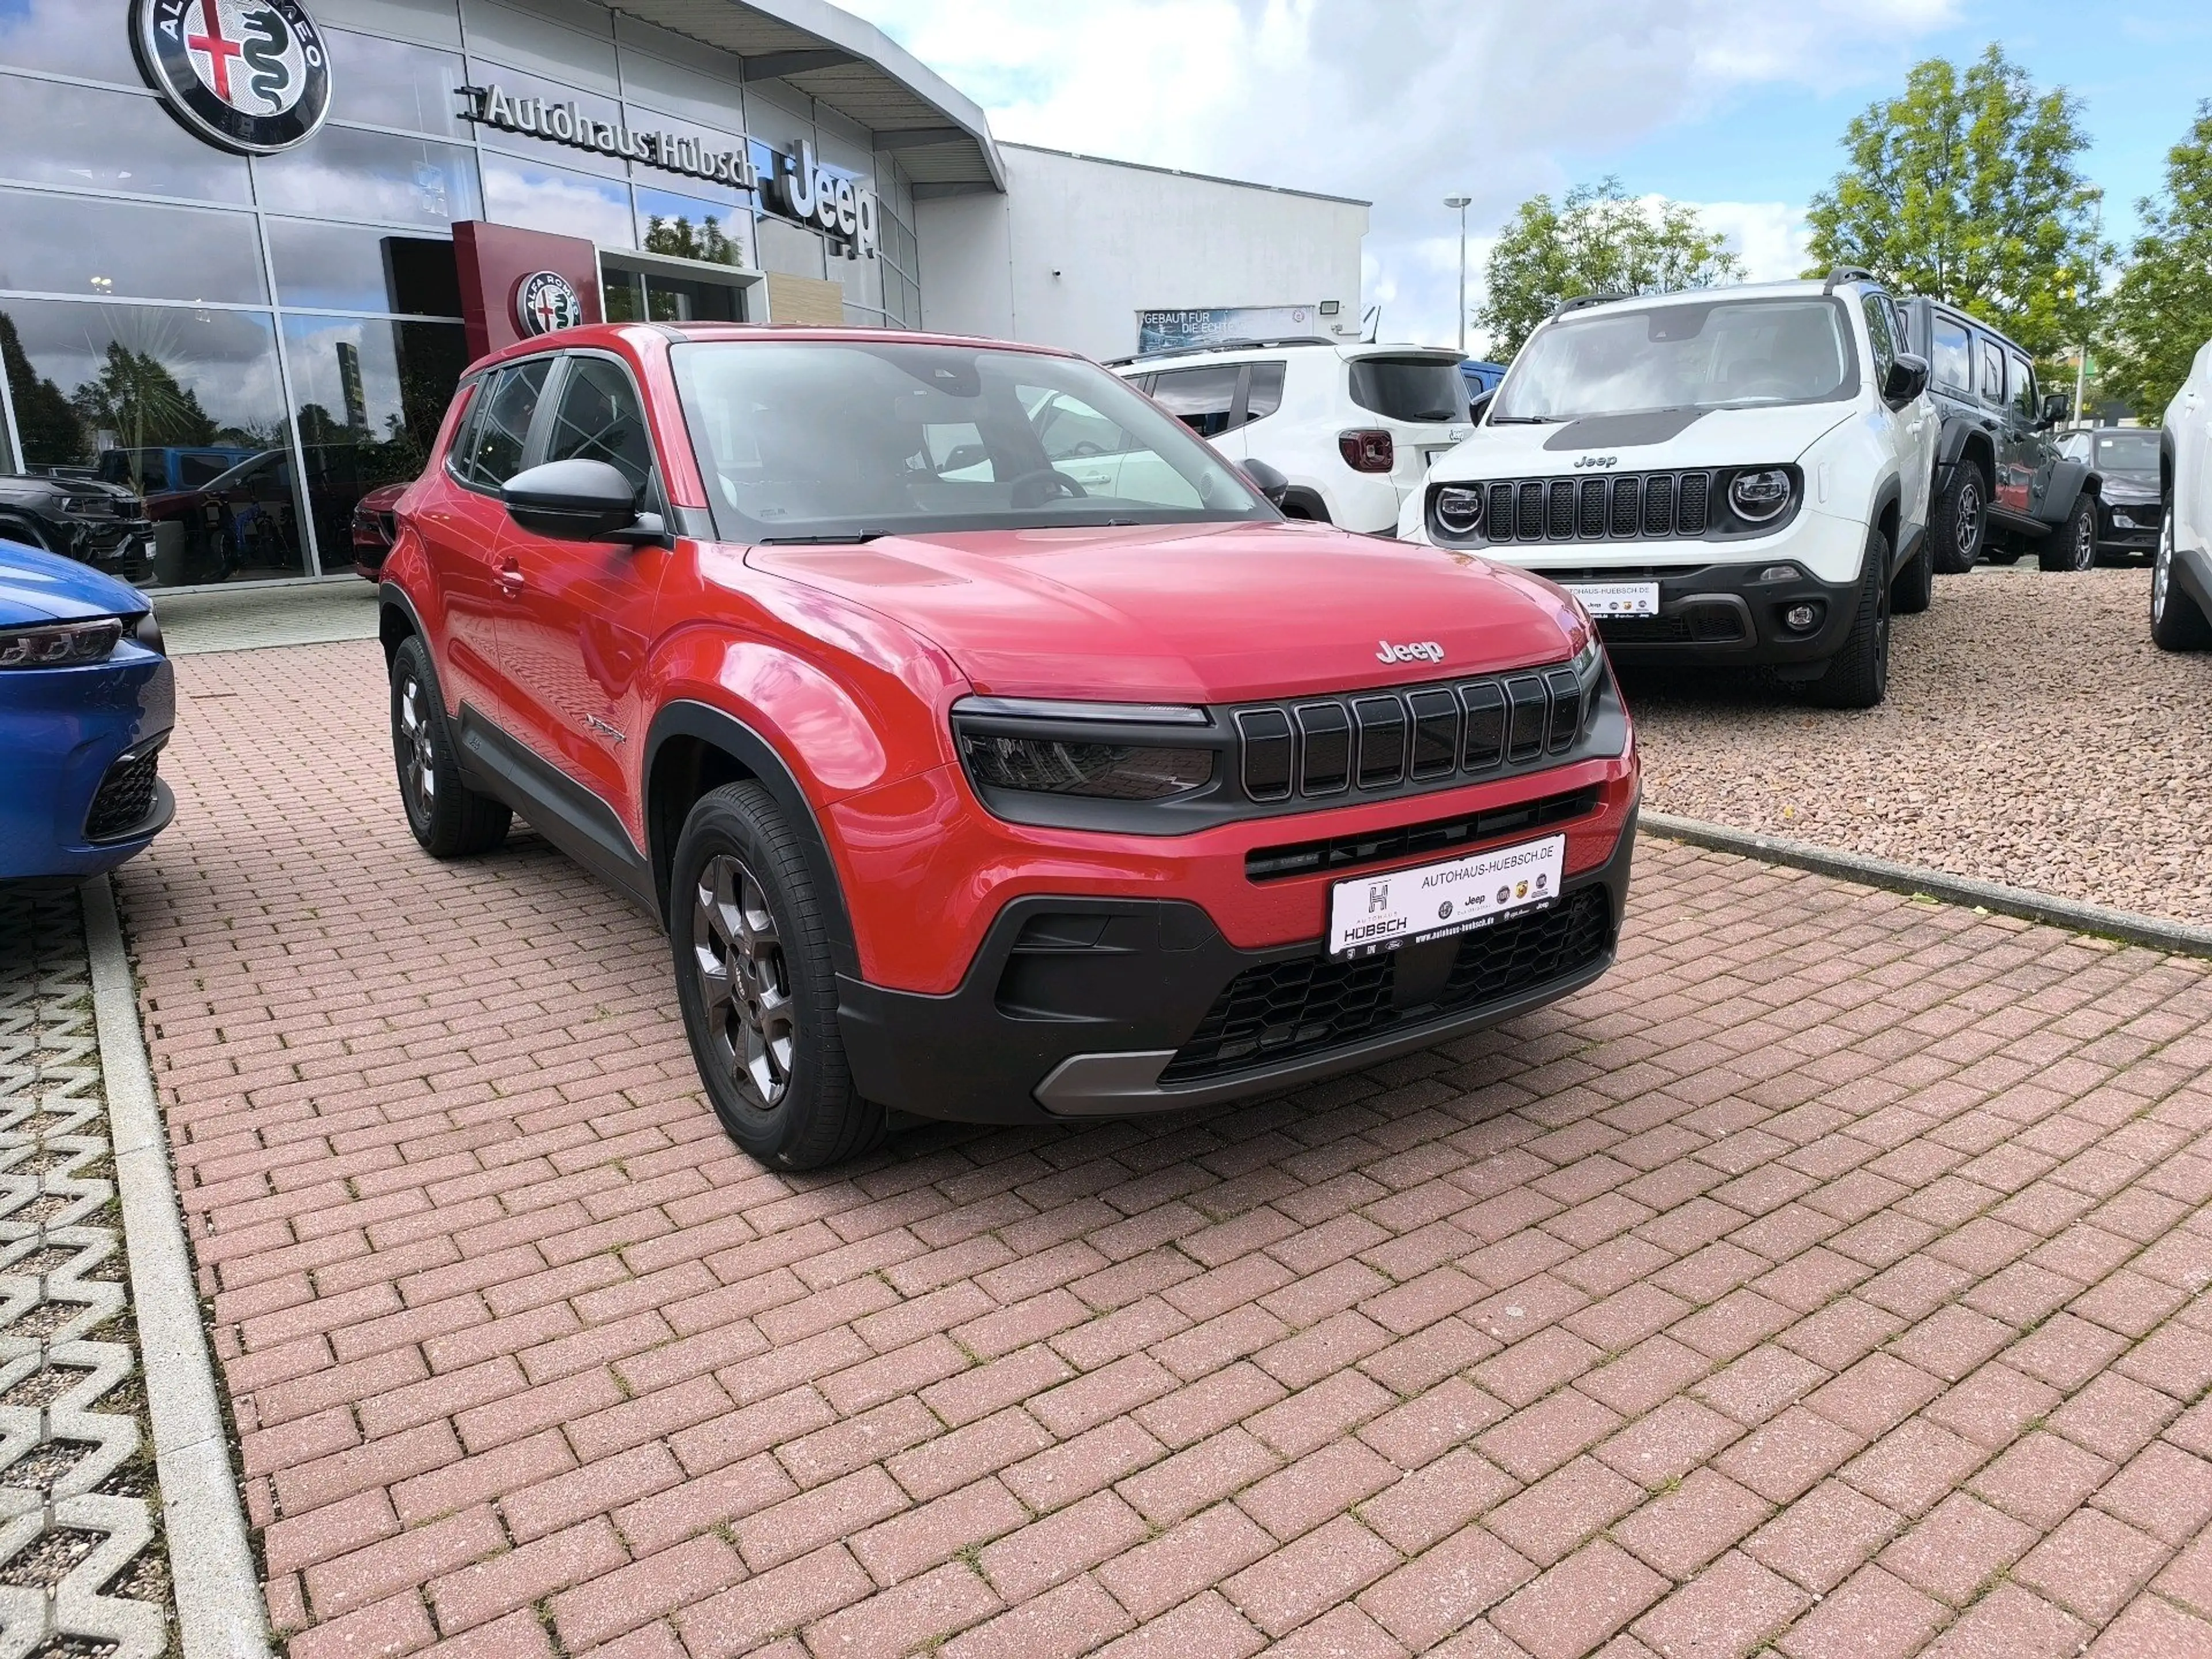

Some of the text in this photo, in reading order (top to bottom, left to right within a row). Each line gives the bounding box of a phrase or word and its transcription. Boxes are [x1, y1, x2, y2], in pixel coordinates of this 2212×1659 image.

[485, 84, 758, 189] Autohaus Hübsch
[783, 139, 877, 255] Jeep
[528, 275, 579, 316] ALFA ROMEO
[1144, 310, 1210, 324] GEBAUT FÜR
[1182, 323, 1199, 334] DIE
[1574, 456, 1617, 468] Jeep
[1376, 641, 1445, 664] Jeep
[1421, 845, 1554, 888] AUTOHAUS-HUEBSCH.DE
[1465, 895, 1486, 906] Jeep
[1344, 917, 1407, 942] HÜBSCH
